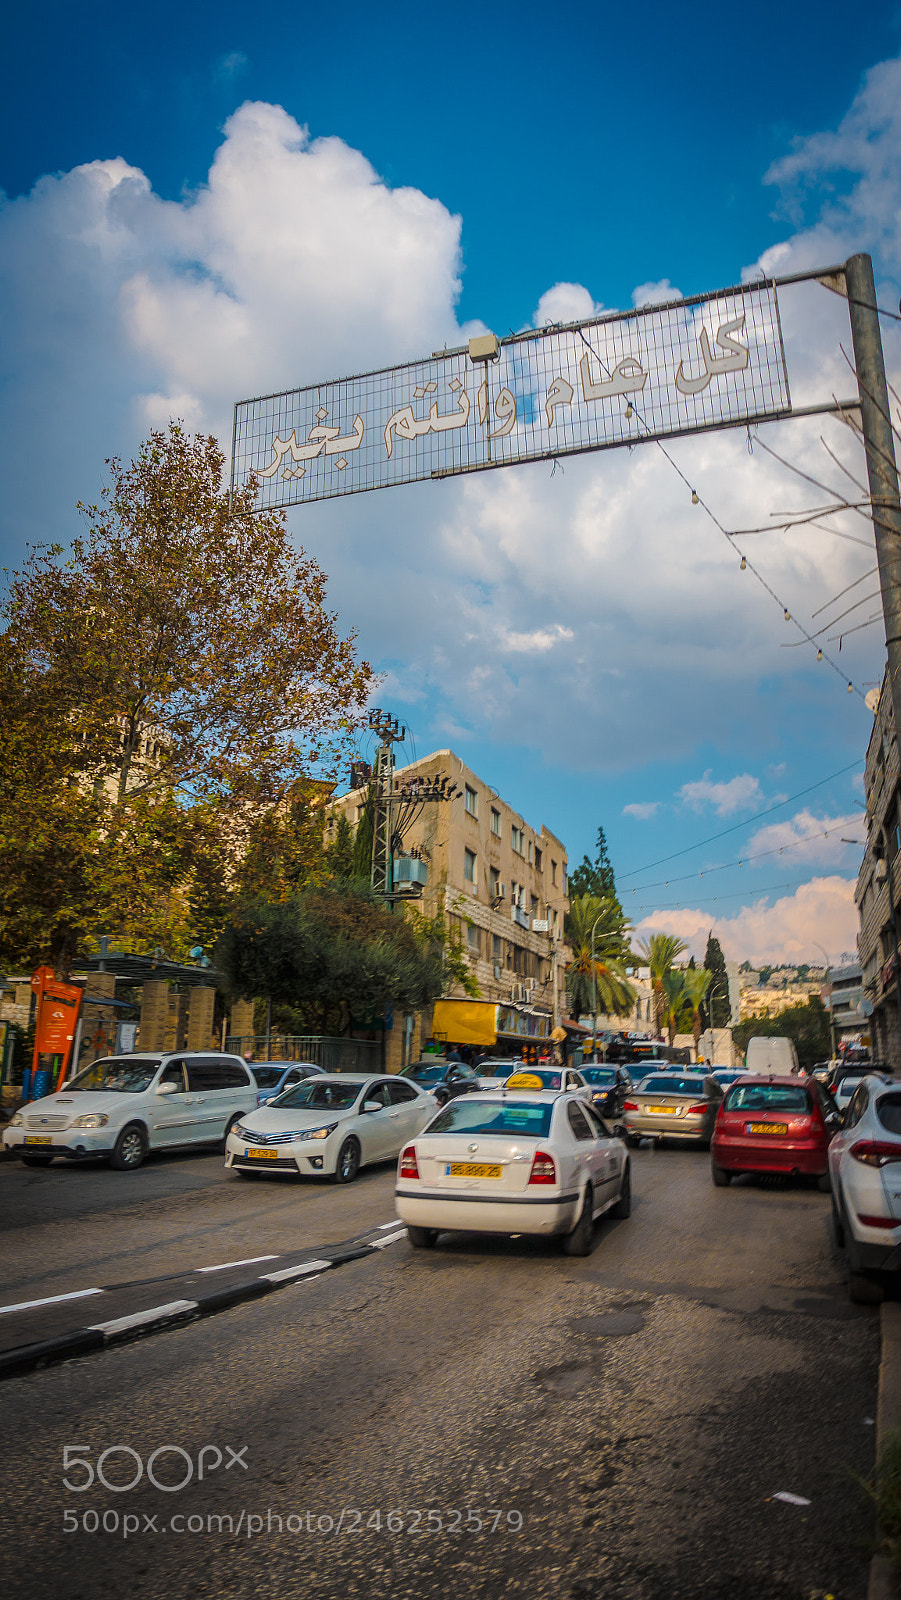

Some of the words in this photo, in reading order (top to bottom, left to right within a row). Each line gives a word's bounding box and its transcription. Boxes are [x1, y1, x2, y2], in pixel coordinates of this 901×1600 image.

[546, 351, 649, 428] عام
[675, 316, 750, 396] كل
[256, 407, 364, 480] بخير
[385, 376, 518, 459] وانتم
